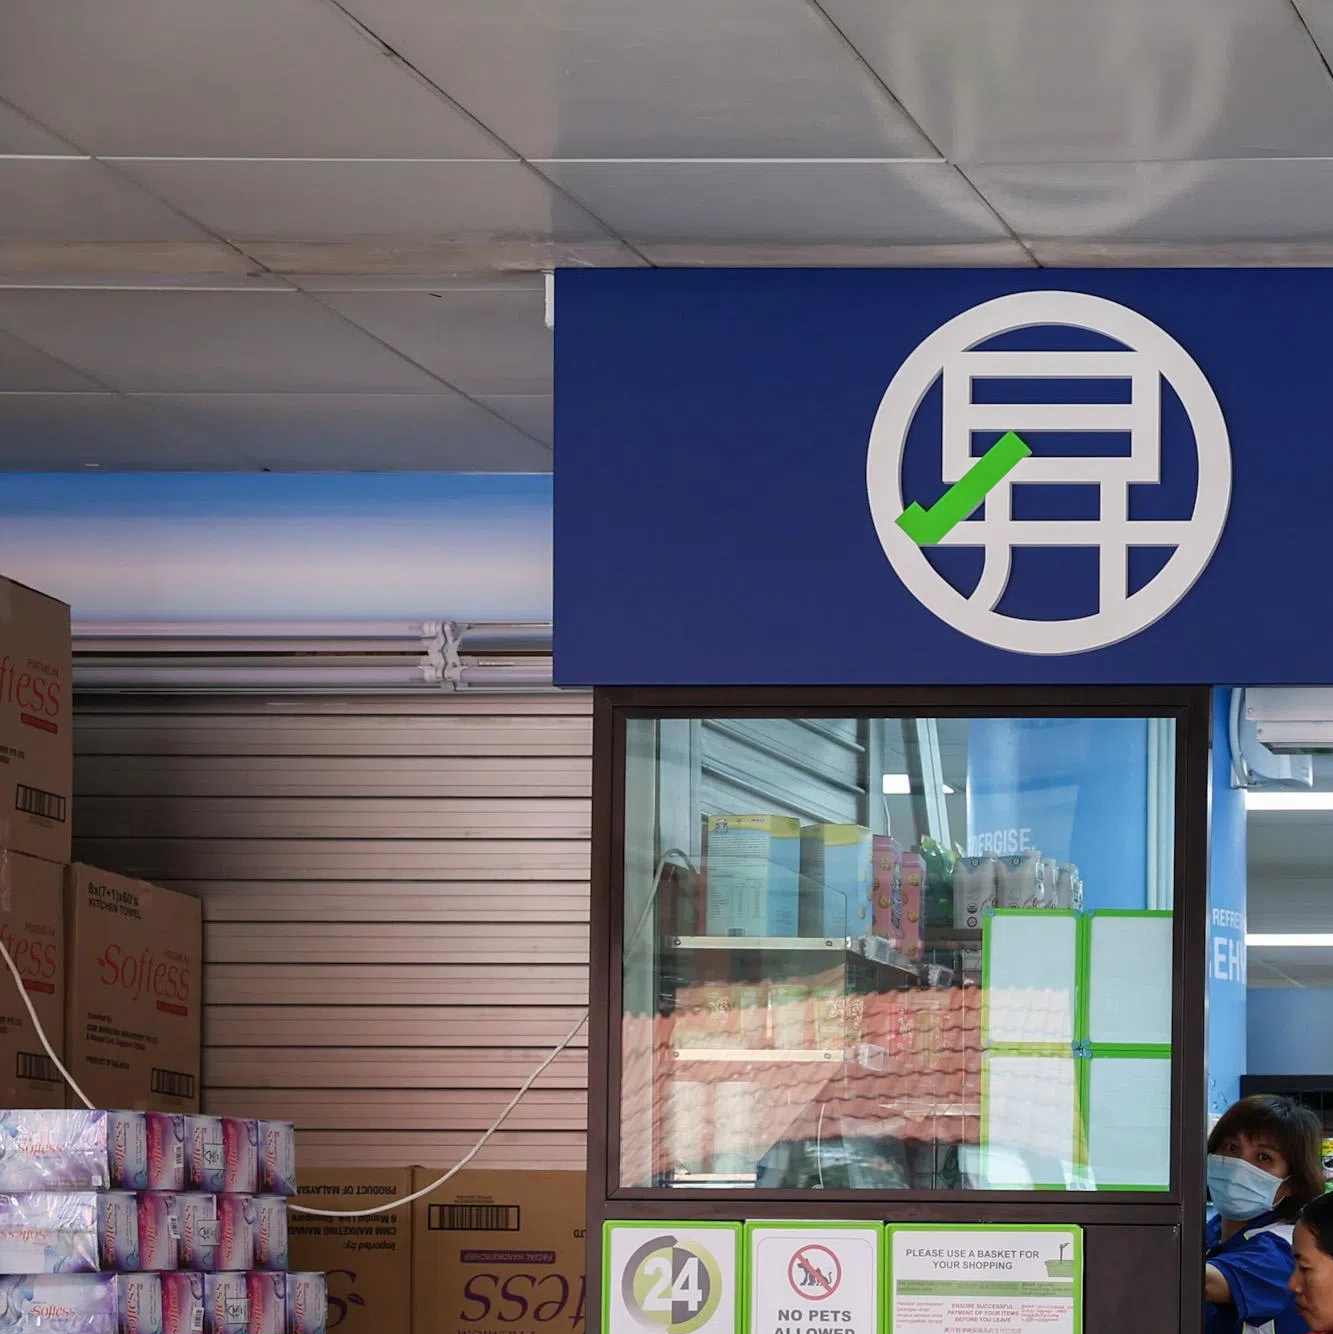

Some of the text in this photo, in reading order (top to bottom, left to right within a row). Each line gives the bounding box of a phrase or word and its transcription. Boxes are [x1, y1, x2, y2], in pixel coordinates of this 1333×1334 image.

[100, 944, 190, 1002] Softess
[357, 1185, 396, 1194] PRODUCT
[906, 1249, 1039, 1259] PLEASE USE A BASKET FOR
[933, 1261, 1013, 1270] YOUR SHOPPING
[642, 1256, 703, 1312] 24
[31, 1303, 76, 1318] Softess
[778, 1310, 851, 1322] NO PETS
